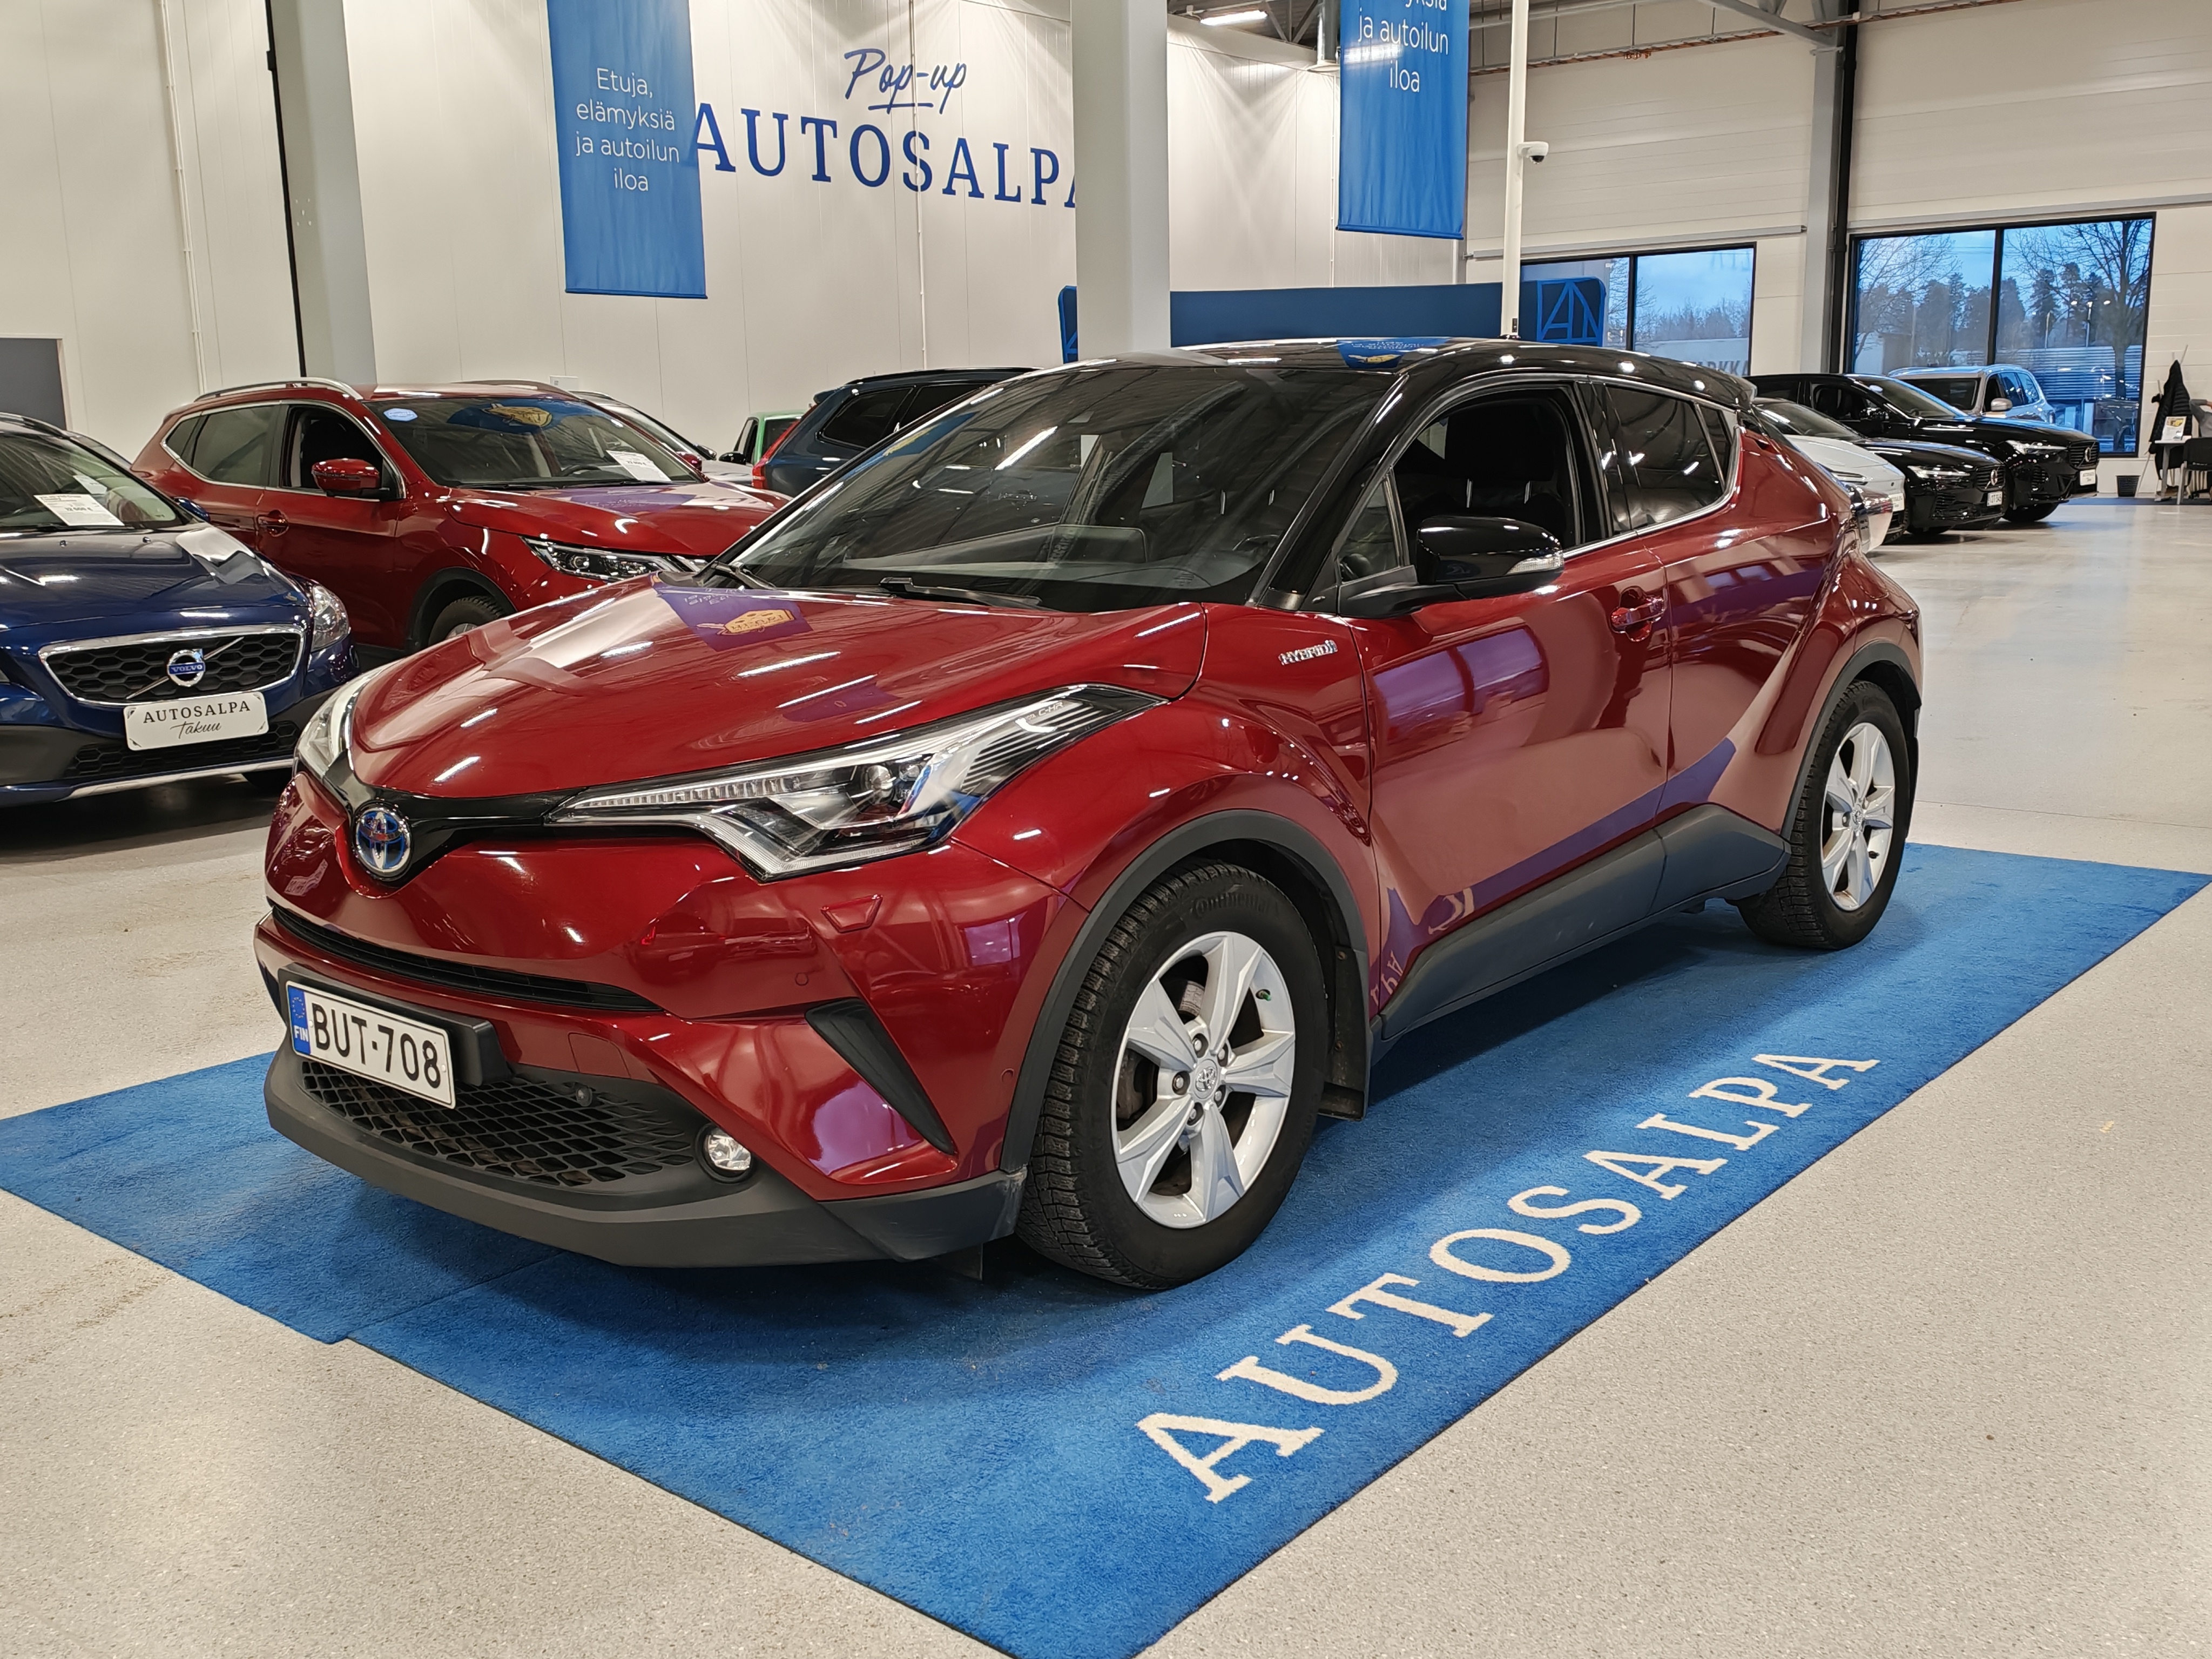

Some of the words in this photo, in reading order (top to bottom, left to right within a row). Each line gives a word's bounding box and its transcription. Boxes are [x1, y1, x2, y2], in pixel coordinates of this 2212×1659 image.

[1358, 7, 1373, 42] ja
[1380, 18, 1448, 55] autoilun
[597, 68, 653, 98] Etuja,
[844, 48, 967, 114] Pop-up
[1390, 59, 1420, 92] iloa
[576, 98, 675, 131] elämyksiä
[576, 131, 594, 157] ja
[601, 137, 680, 163] autoilun
[694, 102, 1075, 208] AUTOSALP
[613, 167, 649, 191] iloa
[171, 664, 203, 673] VOLVO
[1278, 643, 1331, 666] HYBRID
[143, 700, 251, 724] AUTOSALPA
[1038, 702, 1063, 717] C-HR
[170, 721, 221, 739] Takuu
[294, 1024, 308, 1042] FIN
[312, 1002, 441, 1089] BUT-708
[1135, 1053, 1881, 1504] AUTOSALPA
